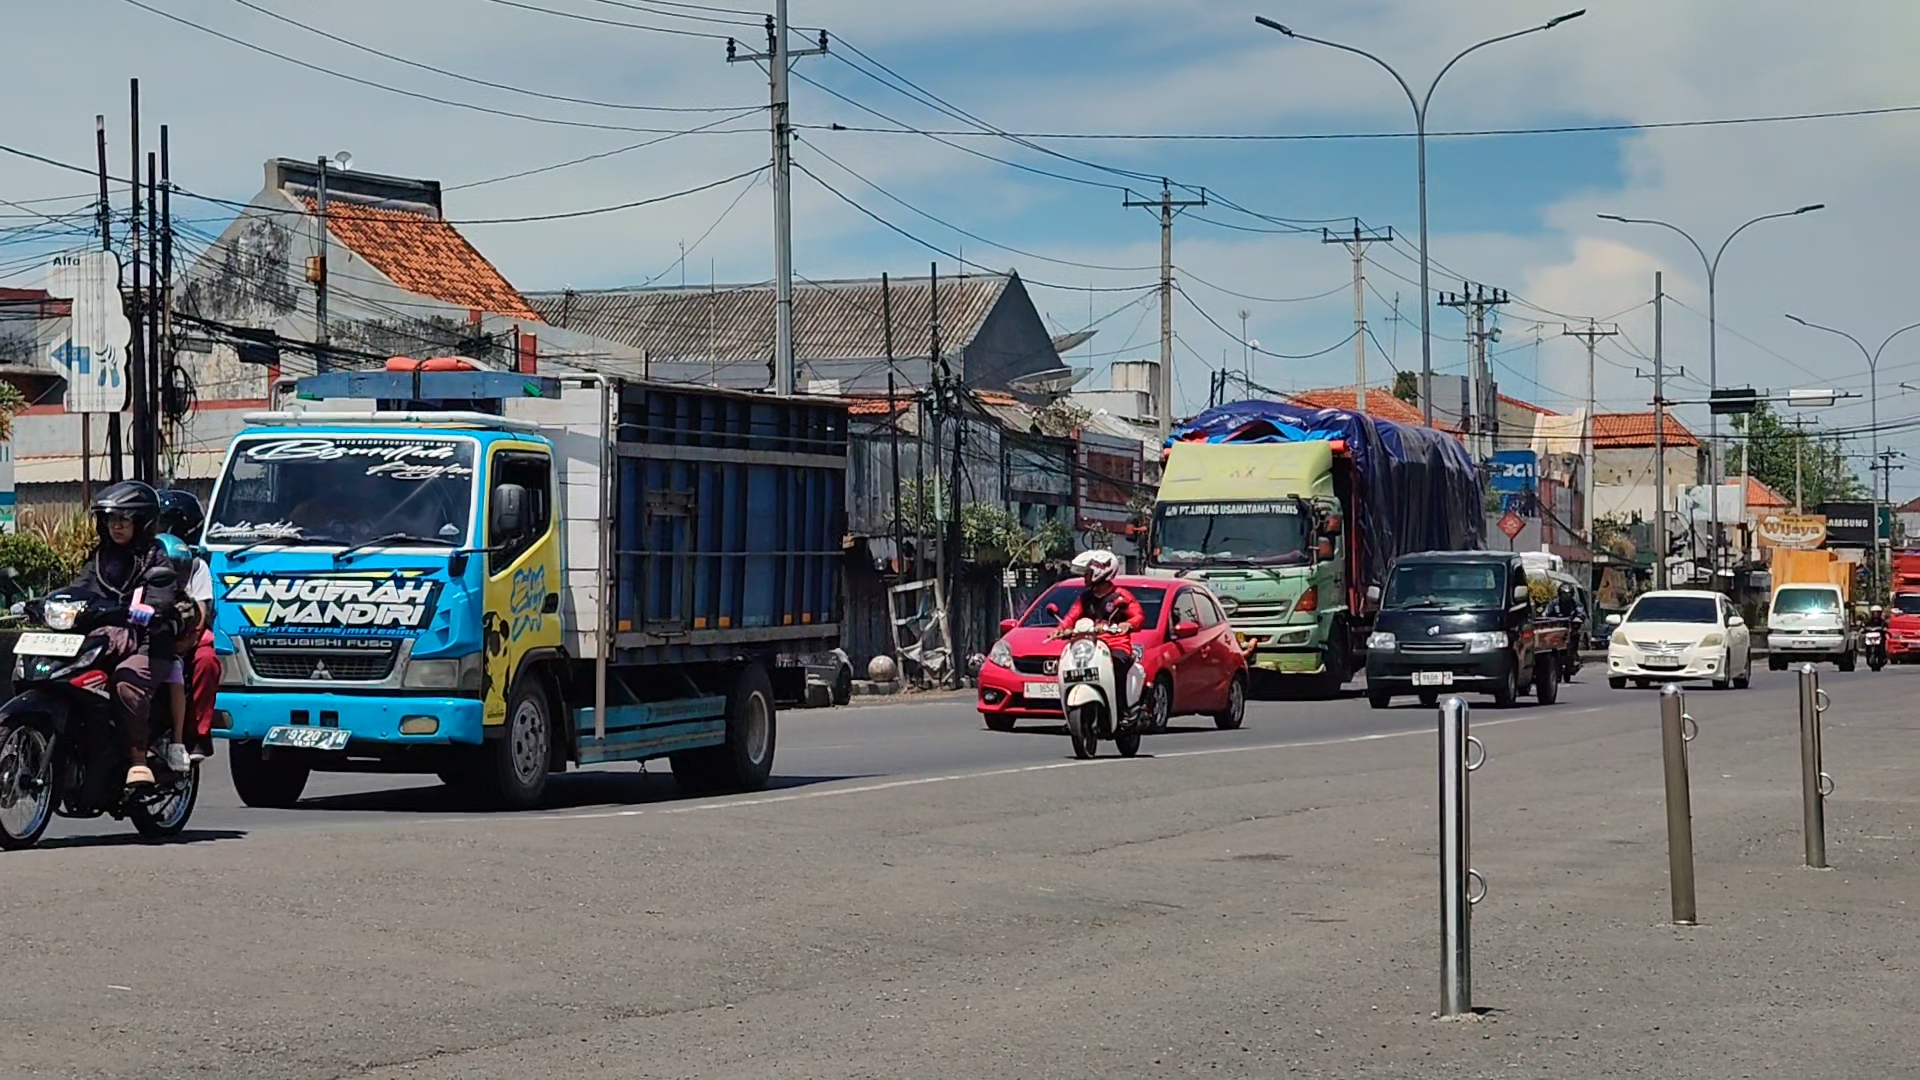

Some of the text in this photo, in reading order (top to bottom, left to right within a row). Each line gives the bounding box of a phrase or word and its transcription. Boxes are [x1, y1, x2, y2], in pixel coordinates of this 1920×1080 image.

[1828, 518, 1869, 528] AMSUNG
[226, 578, 434, 603] ANUGERAH
[267, 600, 426, 625] MANDIRI
[250, 638, 393, 648] MITSUBISHI FUSO
